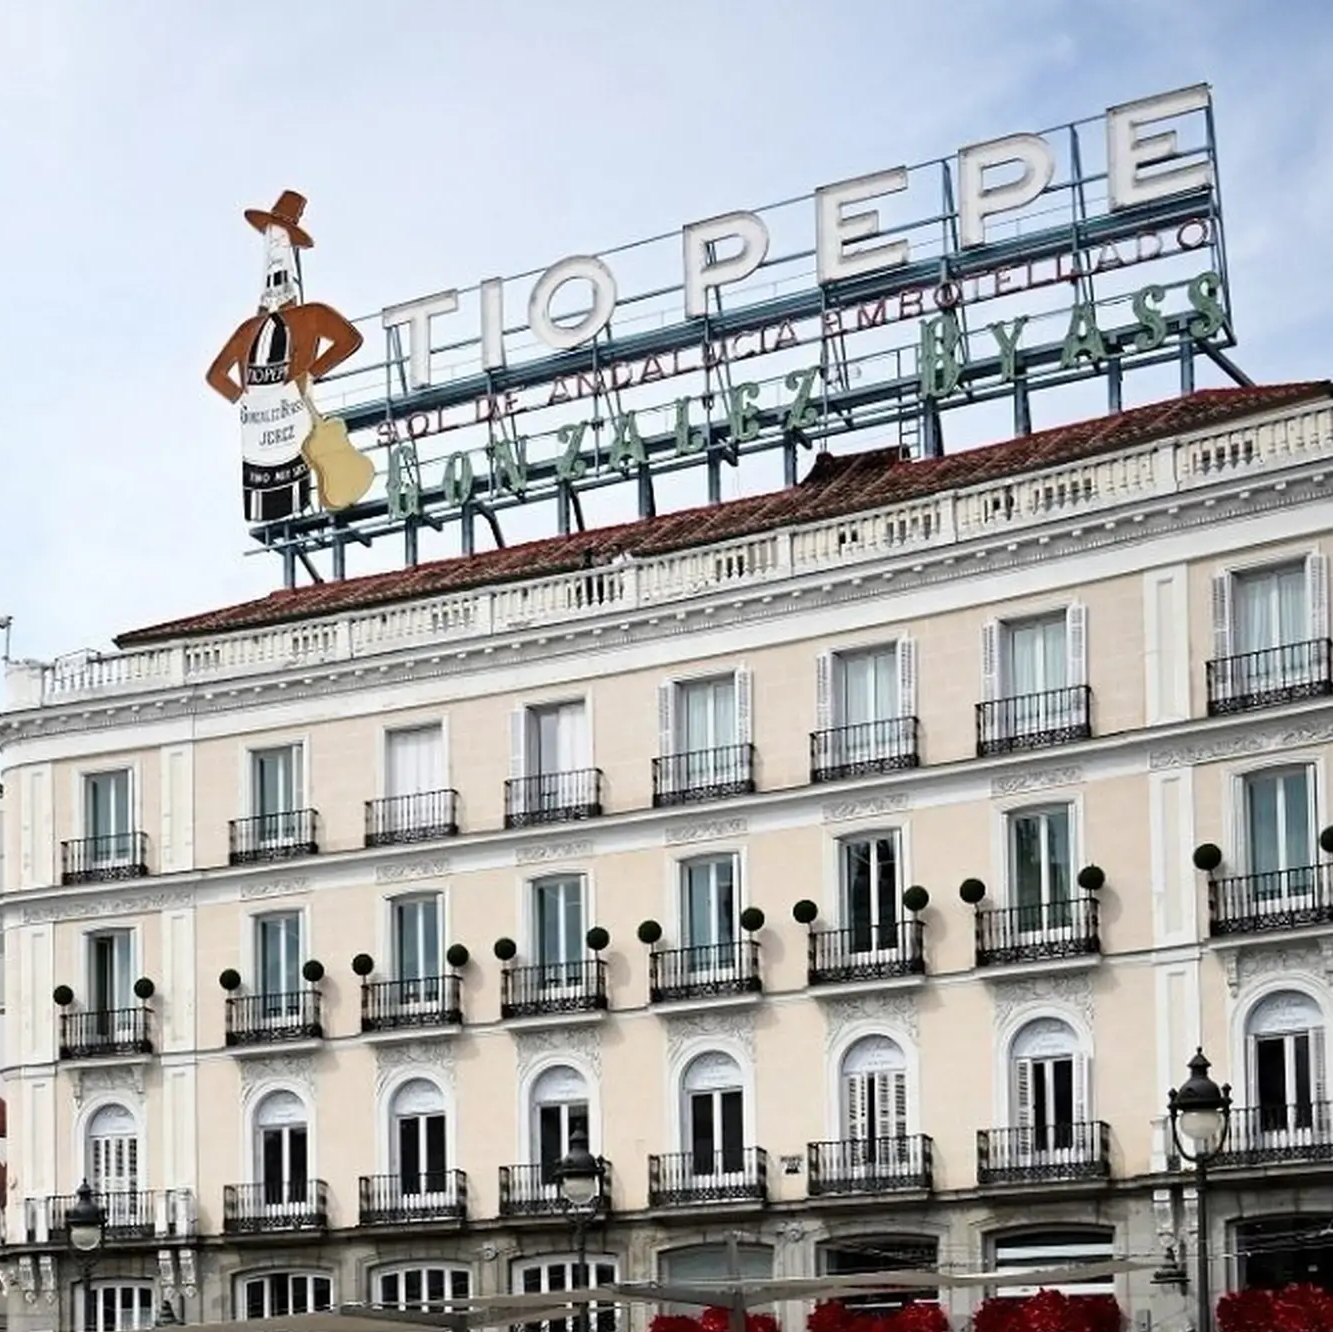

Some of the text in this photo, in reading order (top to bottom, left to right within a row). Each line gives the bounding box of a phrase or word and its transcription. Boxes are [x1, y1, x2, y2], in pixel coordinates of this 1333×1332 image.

[382, 82, 1213, 389] TIO PEPE
[386, 272, 1226, 519] GONZALEZ BYASS
